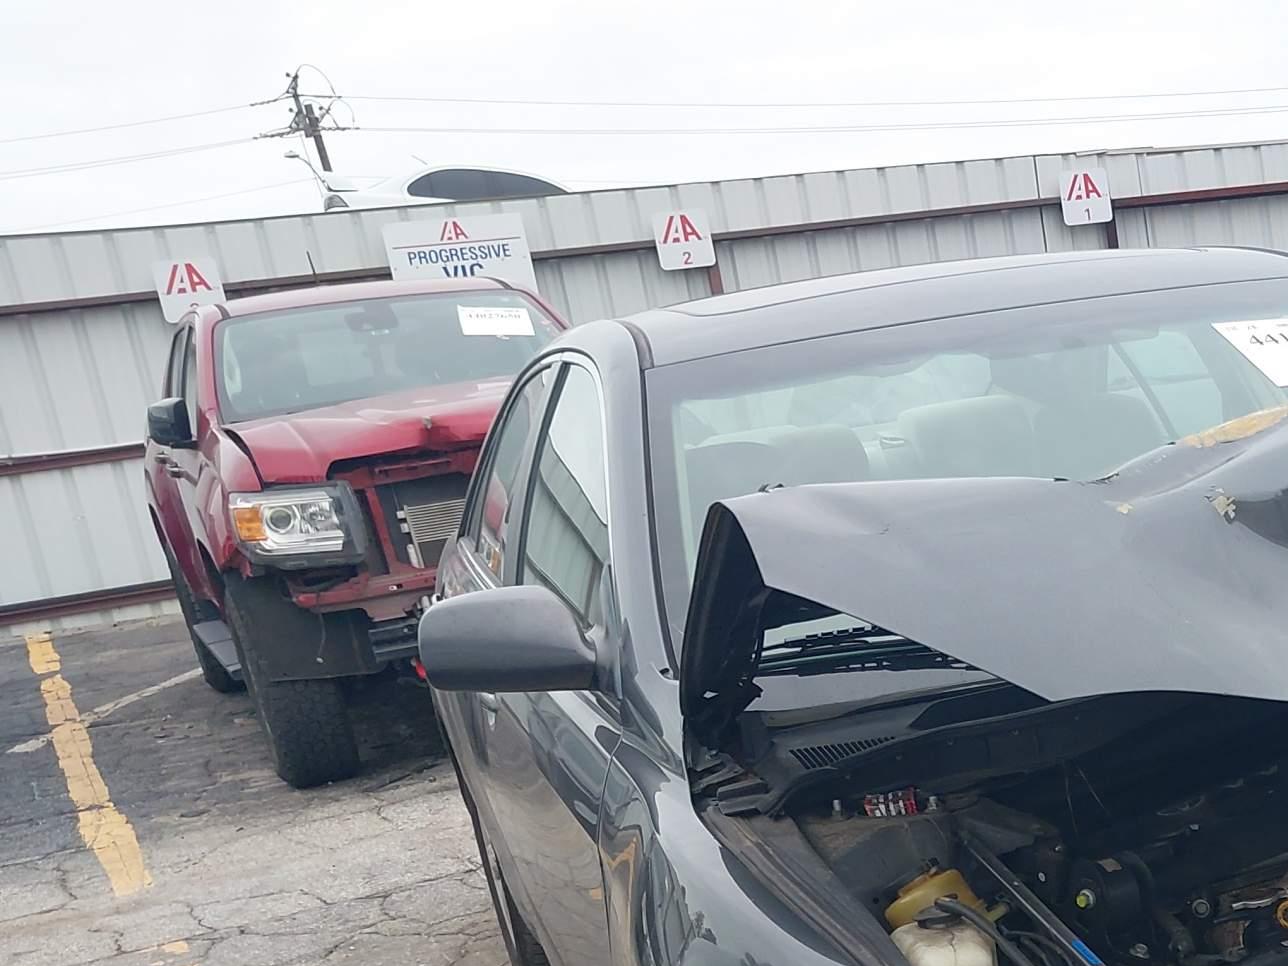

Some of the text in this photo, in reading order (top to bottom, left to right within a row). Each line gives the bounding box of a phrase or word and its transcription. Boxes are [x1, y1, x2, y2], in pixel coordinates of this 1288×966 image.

[1084, 207, 1091, 221] 1
[407, 243, 511, 266] PROGRESSIVE
[682, 251, 694, 265] 2
